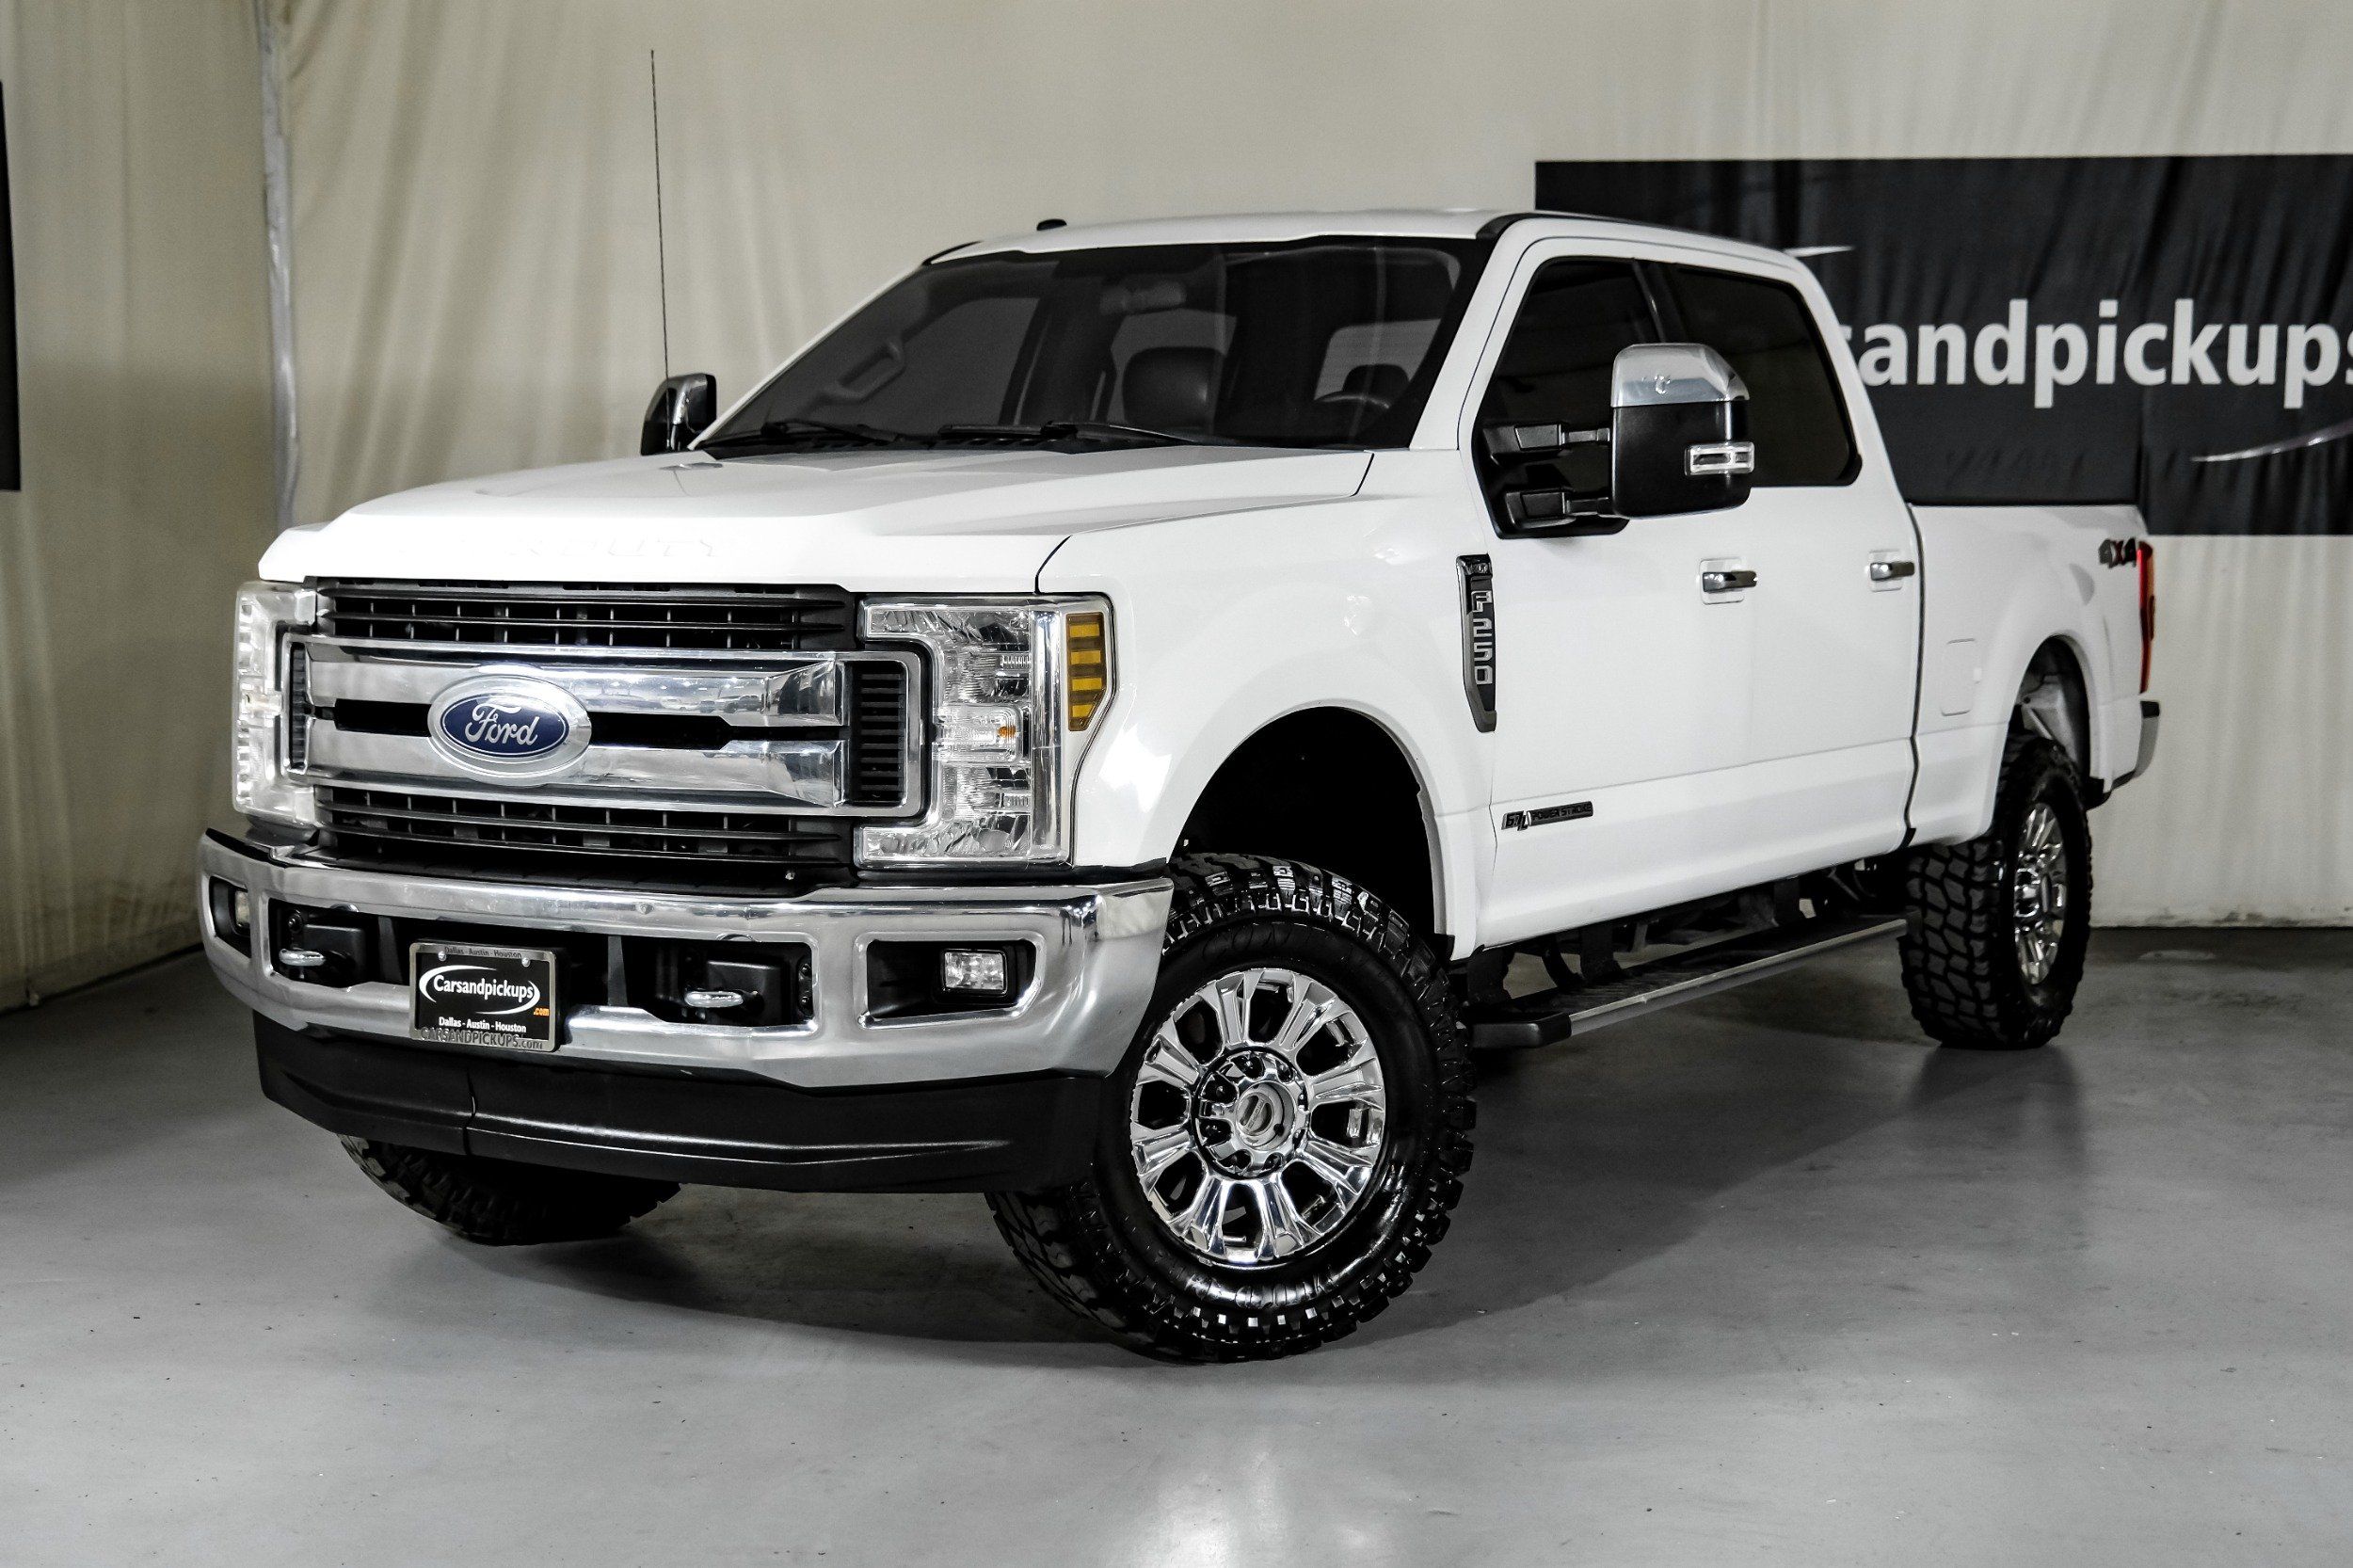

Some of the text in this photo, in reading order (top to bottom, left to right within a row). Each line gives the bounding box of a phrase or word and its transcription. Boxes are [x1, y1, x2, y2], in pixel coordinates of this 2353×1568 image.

[1839, 298, 2353, 408] andpickup
[465, 703, 540, 745] Ford
[444, 946, 463, 954] Dallas
[469, 948, 489, 956] Austin
[494, 949, 521, 958] Houston
[433, 975, 534, 1002] Carsandpickups
[439, 1016, 461, 1027] Dallas
[467, 1018, 490, 1030] Austin
[495, 1021, 527, 1032] Houston
[421, 1027, 543, 1049] CARSANDPICKUPS.com
